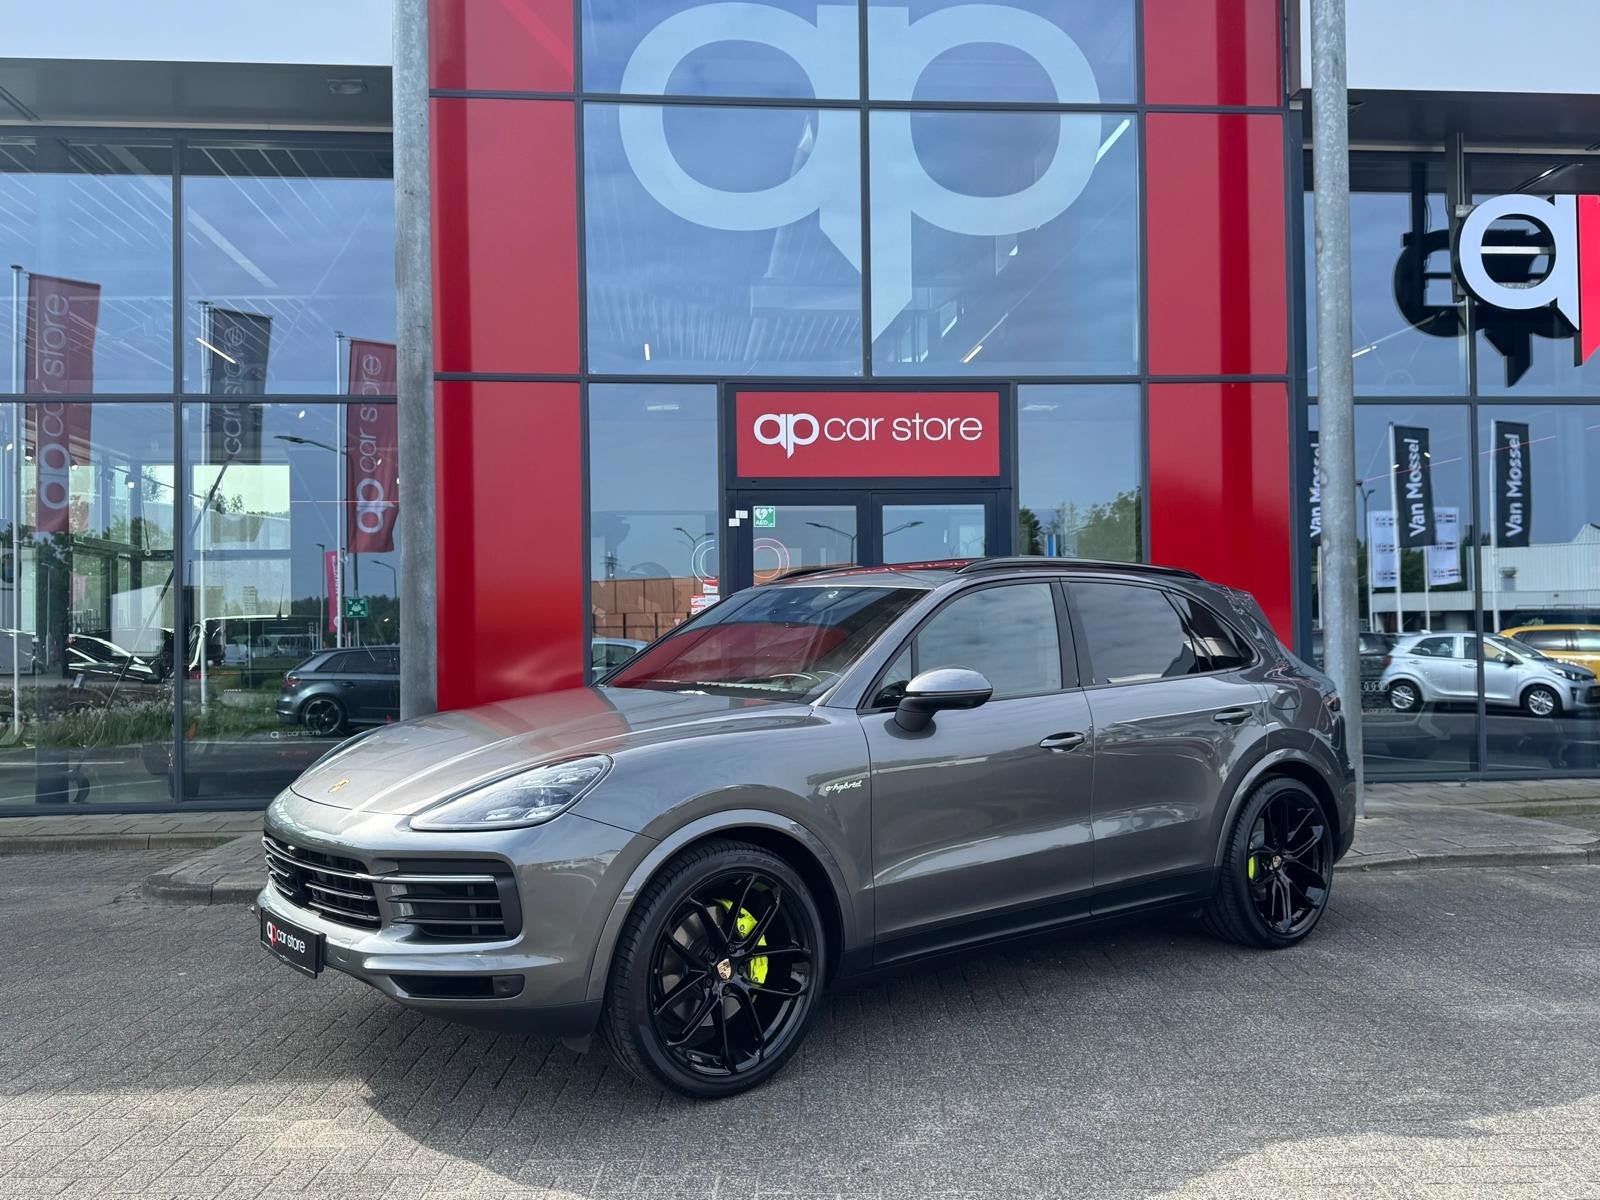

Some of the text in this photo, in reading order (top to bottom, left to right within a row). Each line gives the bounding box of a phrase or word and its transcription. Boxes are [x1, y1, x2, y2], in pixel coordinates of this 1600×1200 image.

[619, 1, 1101, 343] ap
[1458, 193, 1600, 365] a
[40, 294, 69, 378] store
[356, 354, 396, 534] ap car sore
[753, 412, 983, 459] ap car store
[1504, 433, 1523, 537] Van Mossel
[1403, 438, 1427, 537] Van Mossel
[267, 921, 305, 953] ap car store
